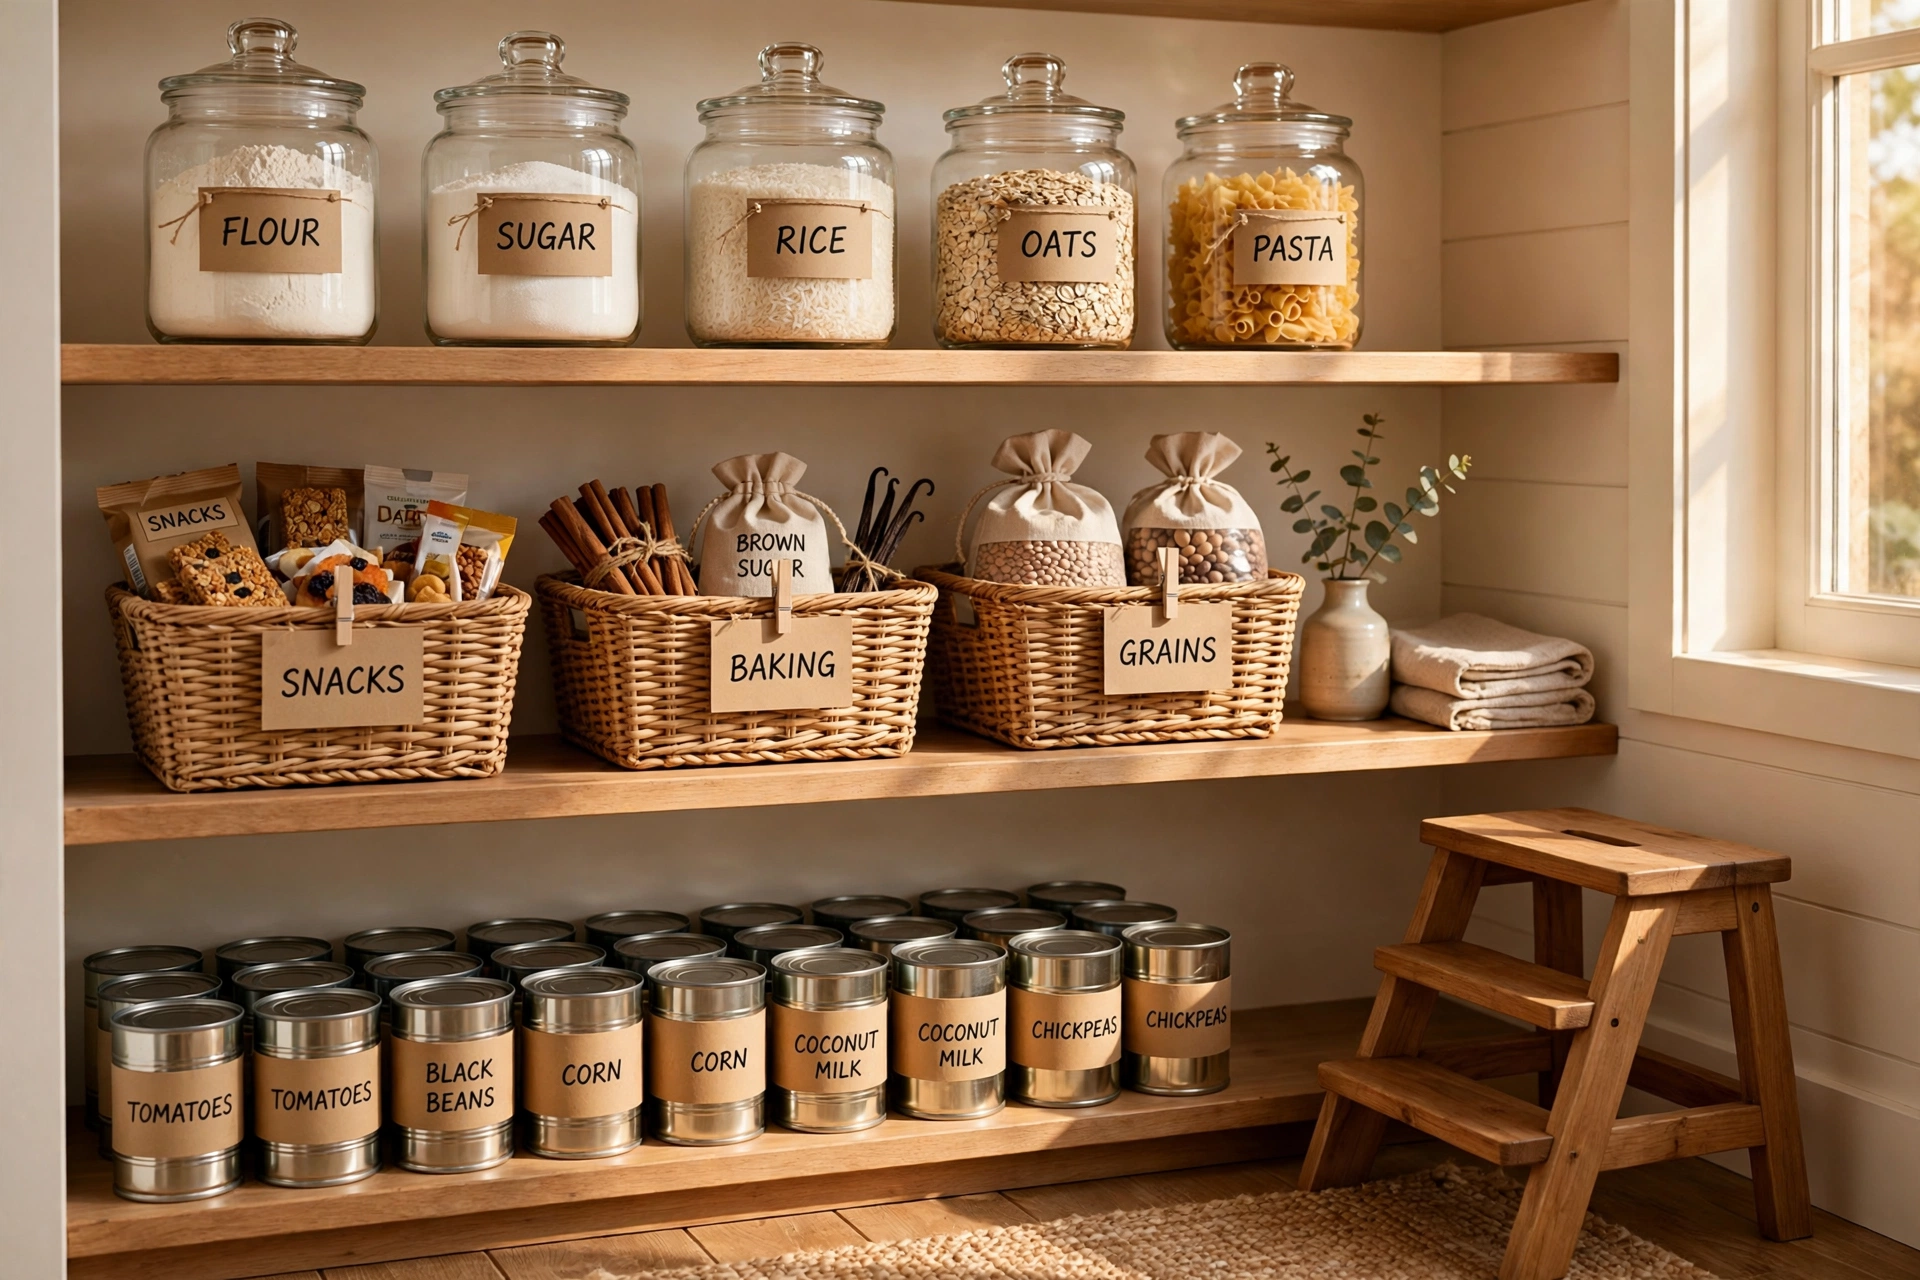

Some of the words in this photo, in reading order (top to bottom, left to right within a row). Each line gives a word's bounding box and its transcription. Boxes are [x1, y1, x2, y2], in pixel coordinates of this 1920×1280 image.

[222, 215, 320, 247] FLOUR
[496, 220, 596, 251] SUGAR
[775, 224, 847, 255] RICE
[1020, 229, 1097, 259] OATS
[1252, 234, 1334, 263] PASTA
[147, 504, 226, 532] SNACKS
[736, 532, 805, 553] BROWN
[736, 558, 805, 578] SUGR
[1119, 636, 1216, 667] GRAINS
[730, 650, 836, 683] BAKING
[281, 664, 405, 698] SNACKS
[917, 1017, 1000, 1043] COCONUT
[1031, 1015, 1119, 1041] CHICKPEAS
[1145, 1005, 1228, 1029] CHICKPEAS
[794, 1029, 879, 1055] COCONUT
[425, 1058, 494, 1085] BLACK
[690, 1047, 748, 1074] CORN
[814, 1059, 862, 1080] MILK
[938, 1047, 984, 1068] MILK
[561, 1058, 622, 1087] CORN
[127, 1093, 233, 1124] TOMATOES
[270, 1080, 372, 1111] TOMATOES
[425, 1086, 495, 1114] BEANS
